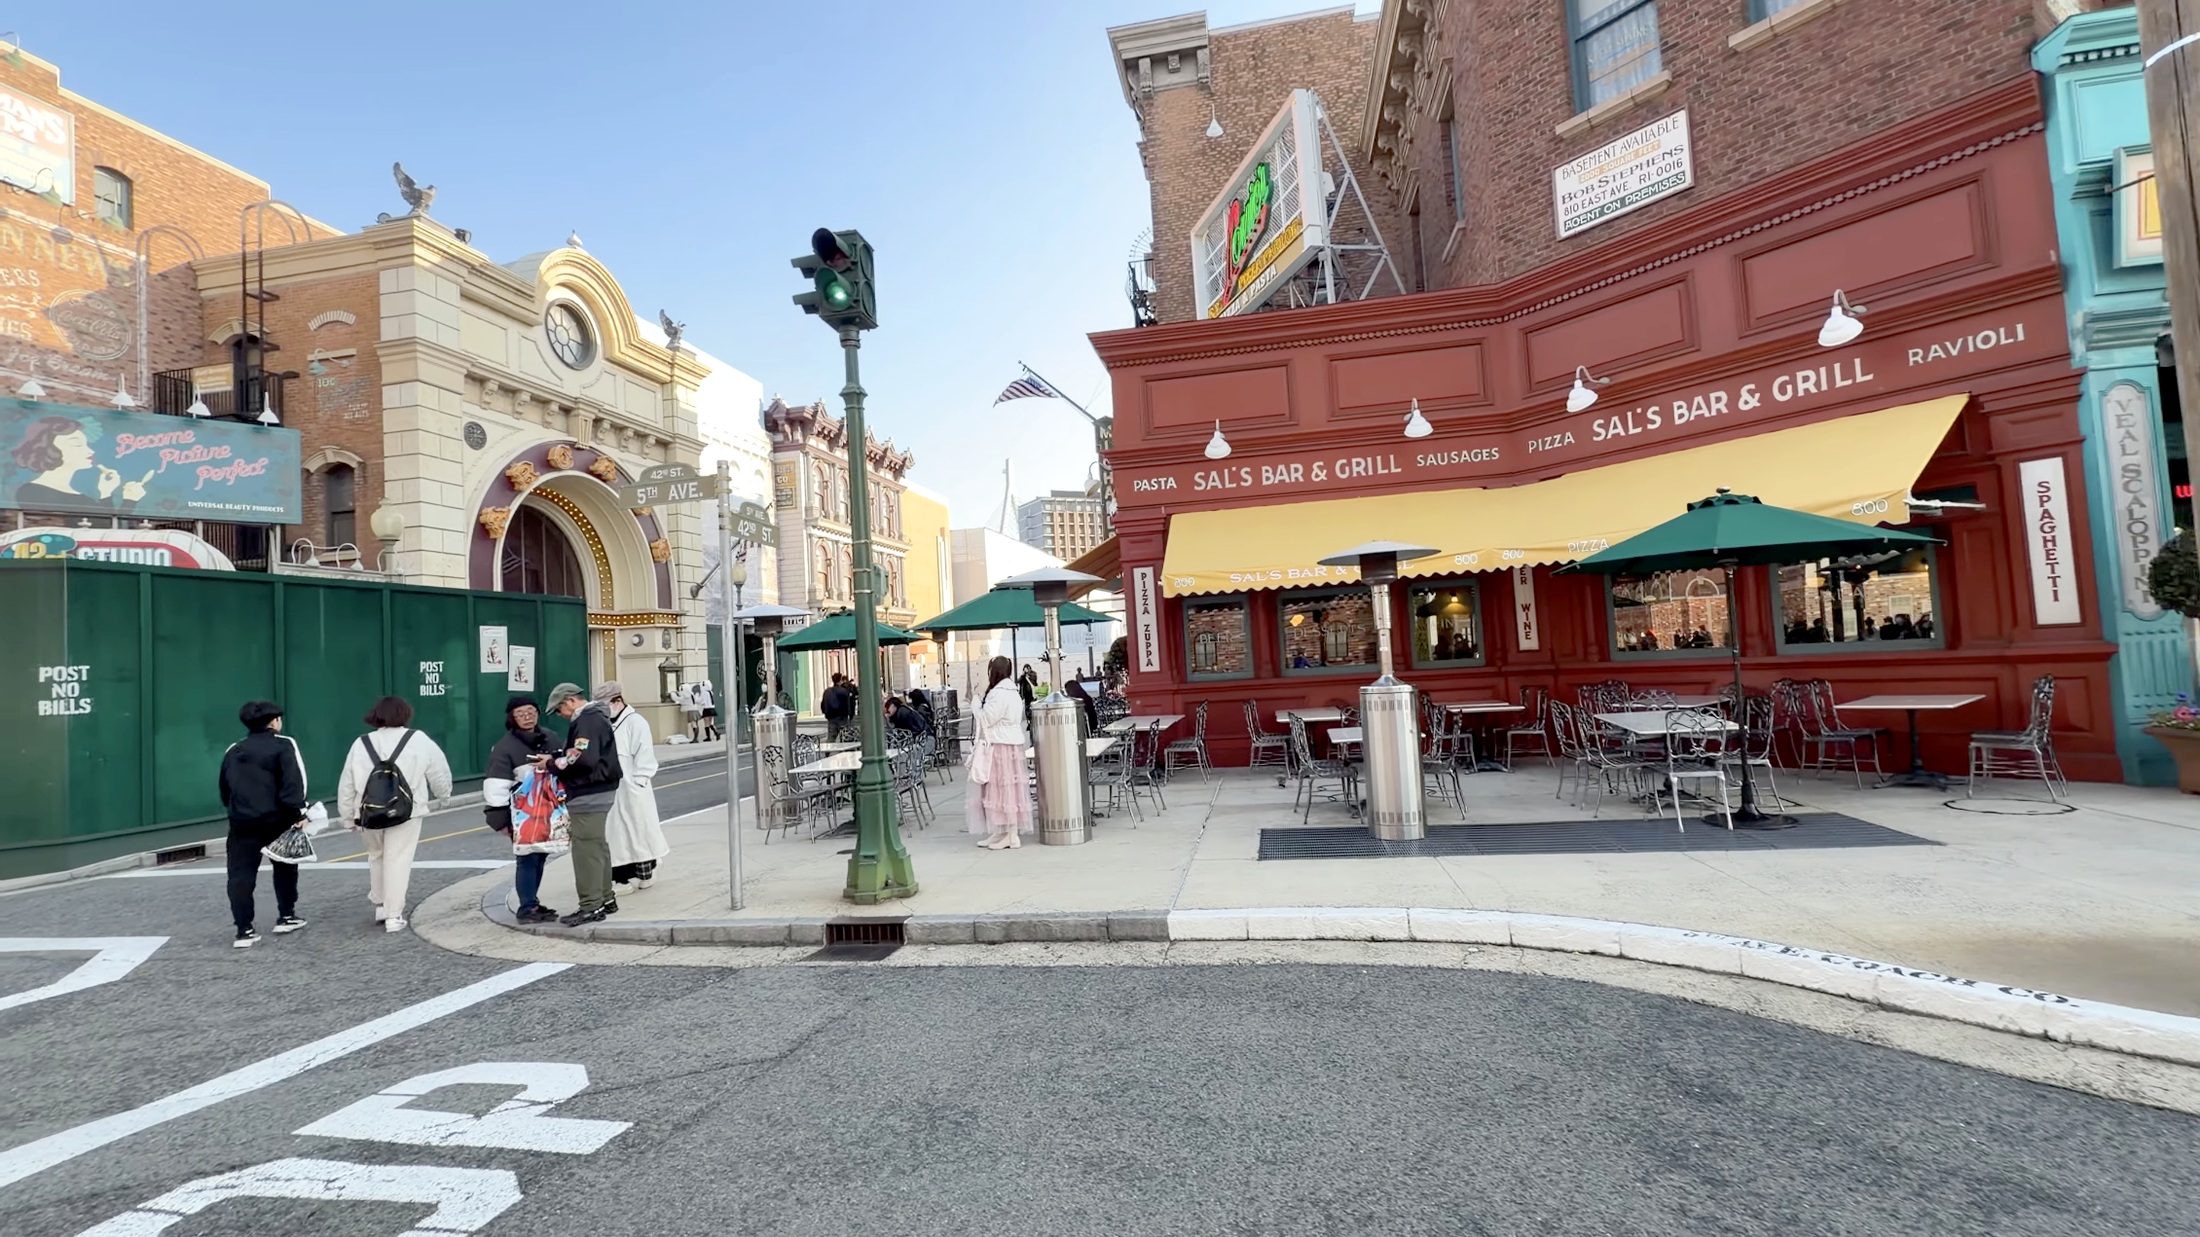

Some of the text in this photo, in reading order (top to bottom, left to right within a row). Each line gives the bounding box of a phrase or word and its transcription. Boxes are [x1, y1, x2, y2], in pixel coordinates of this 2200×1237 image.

[1562, 116, 1680, 180] BASEMENT AVAILABLE
[1603, 152, 1636, 172] SQUARE
[1562, 144, 1684, 205] BOB STEPHENS
[1564, 204, 1579, 216] 810
[1581, 192, 1609, 210] EAST
[1565, 172, 1685, 231] AGENT ON PREMISES
[1251, 264, 1278, 297] PASTA
[1908, 323, 2025, 366] RAVIOLI
[1592, 358, 1874, 442] SAL'S BAR & GRILL
[2114, 399, 2139, 457] VEAL
[115, 430, 195, 459] Become
[1528, 431, 1575, 454] PIZZA
[157, 445, 232, 474] Picture
[1416, 447, 1499, 467] SAUSAGES
[194, 457, 269, 491] Perfect
[669, 467, 684, 477] ST.
[1194, 454, 1402, 491] SAL'S BAR & GRILL
[637, 481, 704, 504] 5TH AVE.
[1133, 476, 1178, 492] PASTA
[188, 501, 284, 513] UNIVERSAL BEAUTY PRODUCTS
[1851, 498, 1888, 516] 800
[762, 527, 775, 544] ST.
[1567, 538, 1609, 554] PIZZA
[2037, 480, 2062, 603] SPAGHETTI
[1454, 554, 1478, 565] 800
[1502, 550, 1524, 560] 800
[1174, 577, 1196, 588] 800
[1229, 570, 1282, 583] SAL'S
[1287, 566, 1327, 579] BAR
[1335, 565, 1347, 575] &
[1140, 572, 1154, 667] PIZZA ZUPPA
[1521, 603, 1532, 640] WINE
[38, 665, 90, 682] POST
[420, 661, 444, 673] POST
[425, 673, 439, 684] NO
[51, 683, 80, 697] NO
[420, 684, 445, 696] BILLS
[38, 698, 92, 716] BILLS
[1821, 954, 1977, 988] COACH
[1998, 986, 2080, 1008] CO.
